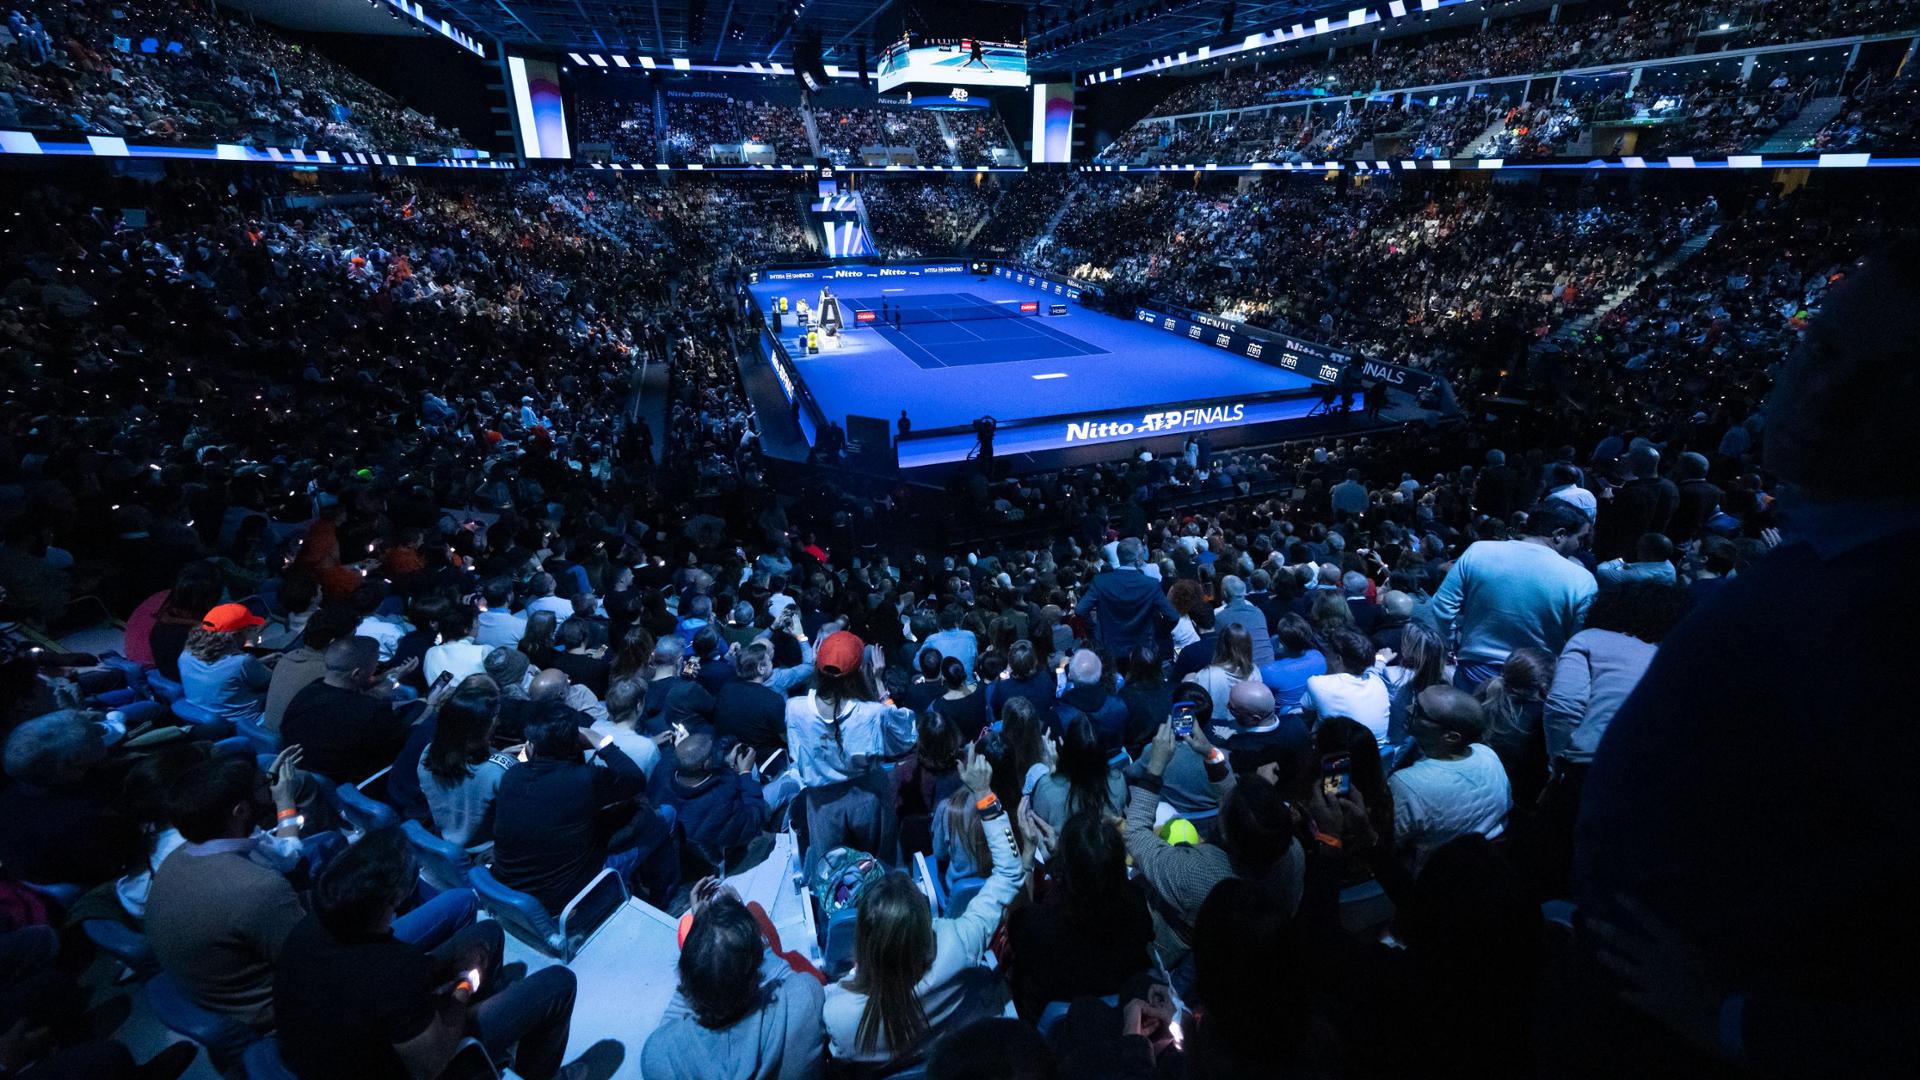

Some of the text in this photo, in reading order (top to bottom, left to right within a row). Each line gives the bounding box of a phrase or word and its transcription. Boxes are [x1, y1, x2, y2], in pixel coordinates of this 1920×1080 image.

[835, 270, 863, 278] Nitto
[880, 268, 907, 276] Nitto
[1247, 345, 1262, 356] iren
[1281, 355, 1297, 368] iren
[1319, 366, 1338, 380] iren
[1362, 361, 1406, 385] INALS
[1066, 404, 1245, 442] Nitto ATP FINALS
